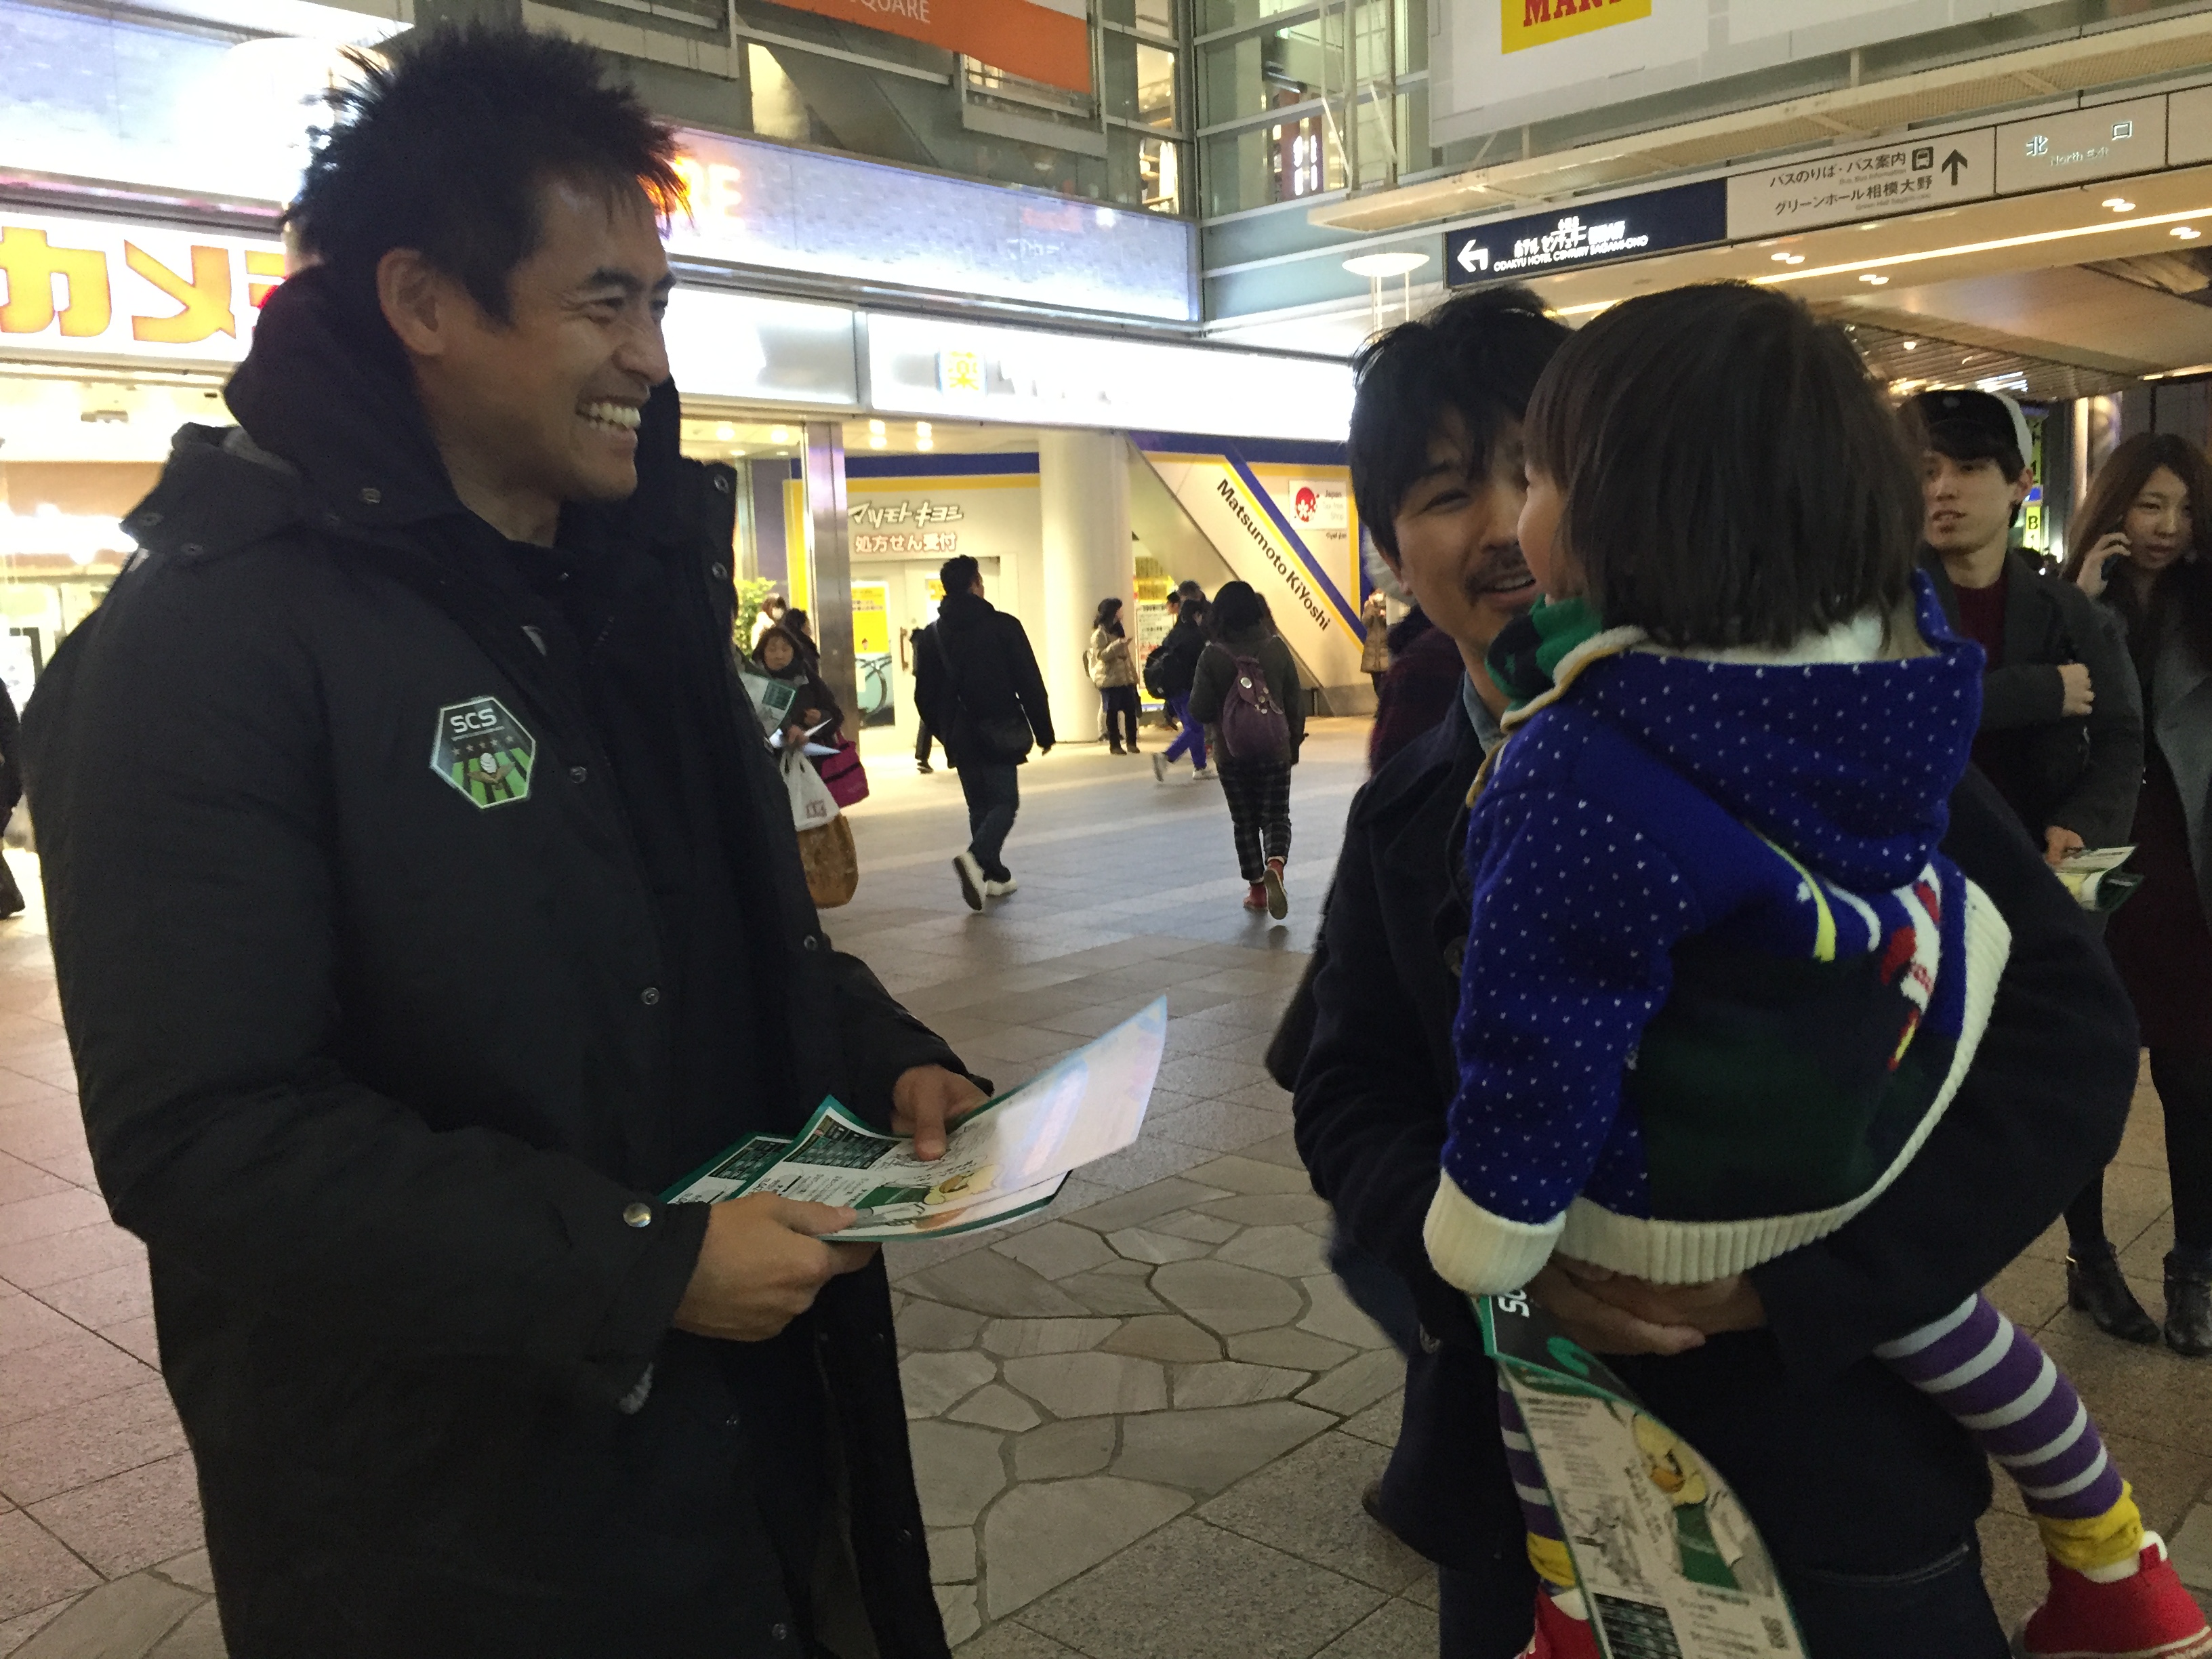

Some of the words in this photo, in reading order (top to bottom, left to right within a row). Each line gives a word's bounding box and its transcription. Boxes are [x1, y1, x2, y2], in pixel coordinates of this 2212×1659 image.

[850, 0, 930, 24] QUARE
[1523, 0, 1622, 28] MAN
[2026, 135, 2049, 157] 北
[2111, 121, 2133, 141] 口
[2050, 151, 2083, 167] North
[1494, 255, 1526, 272] ODAKYU
[1528, 252, 1552, 266] HOTEL
[847, 500, 964, 529] マツモトキヨシ
[1217, 478, 1287, 575] Matsumoto
[450, 708, 497, 733] SCS
